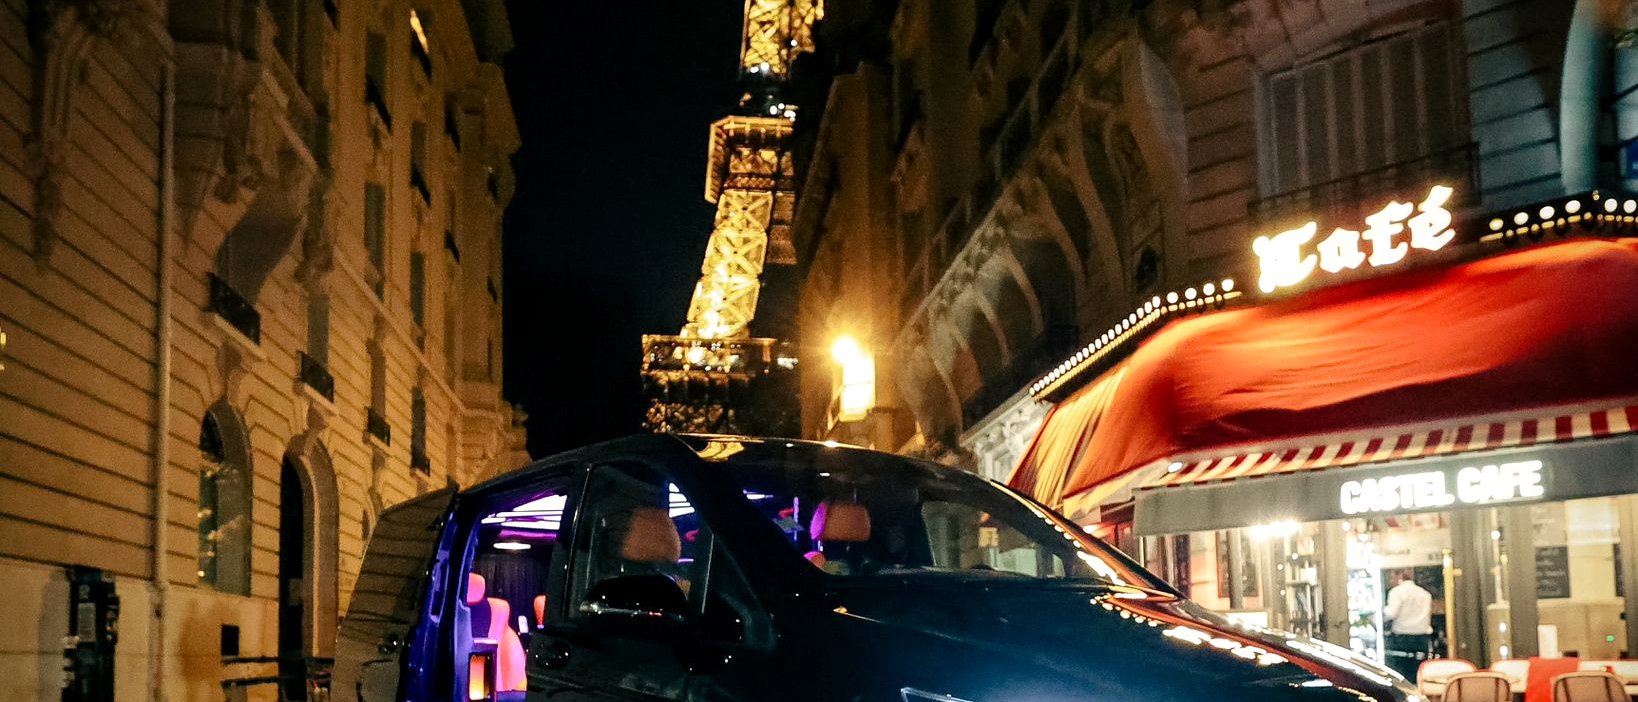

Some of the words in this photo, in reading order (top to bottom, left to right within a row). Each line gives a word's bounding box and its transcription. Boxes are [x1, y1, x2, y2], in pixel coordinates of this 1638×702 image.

[1253, 185, 1455, 293] Café
[1340, 471, 1455, 514] CASTEL
[1457, 460, 1544, 504] CAFE
